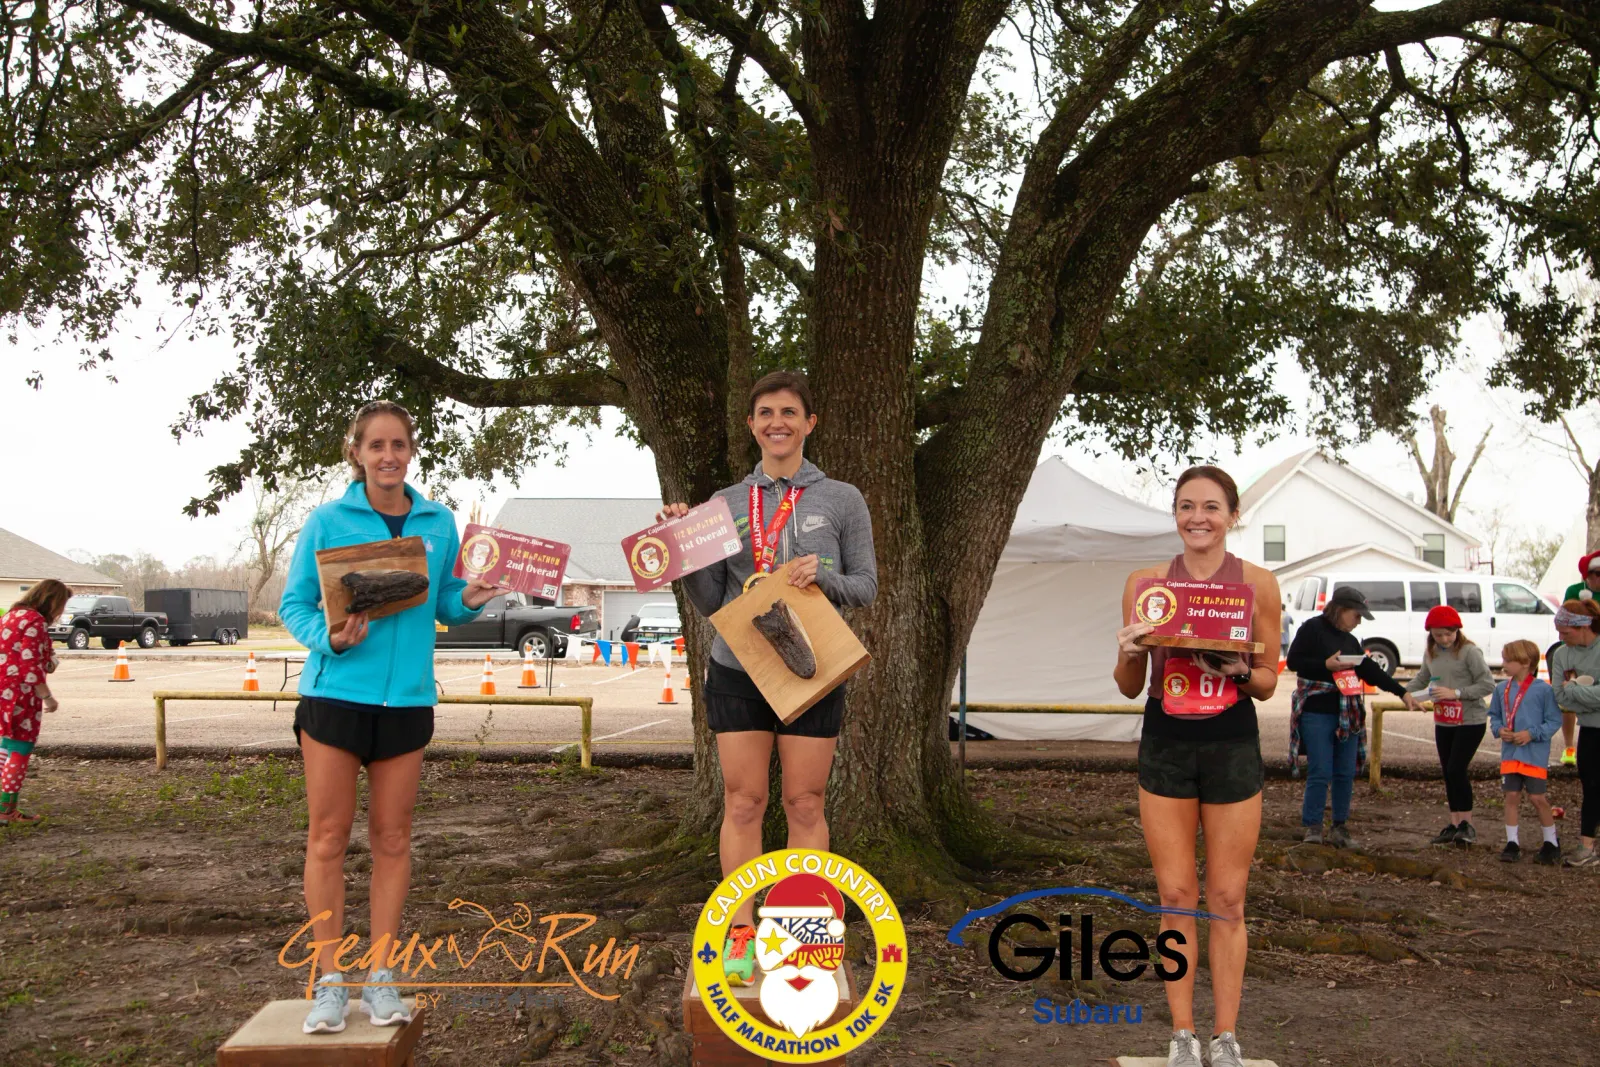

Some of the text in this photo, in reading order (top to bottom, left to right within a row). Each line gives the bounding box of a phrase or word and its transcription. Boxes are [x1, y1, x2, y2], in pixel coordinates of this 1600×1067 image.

[679, 541, 694, 553] 1st
[696, 525, 728, 545] Overall
[727, 542, 738, 552] 20
[506, 559, 524, 571] 2nd
[526, 564, 559, 579] Overall
[1166, 580, 1224, 590] CajunCountry.Run
[545, 588, 555, 597] 20
[1189, 595, 1246, 607] 1/2 MARATHON
[1186, 607, 1245, 620] 3rd Overall
[1234, 630, 1245, 638] 20
[1200, 673, 1227, 698] 67
